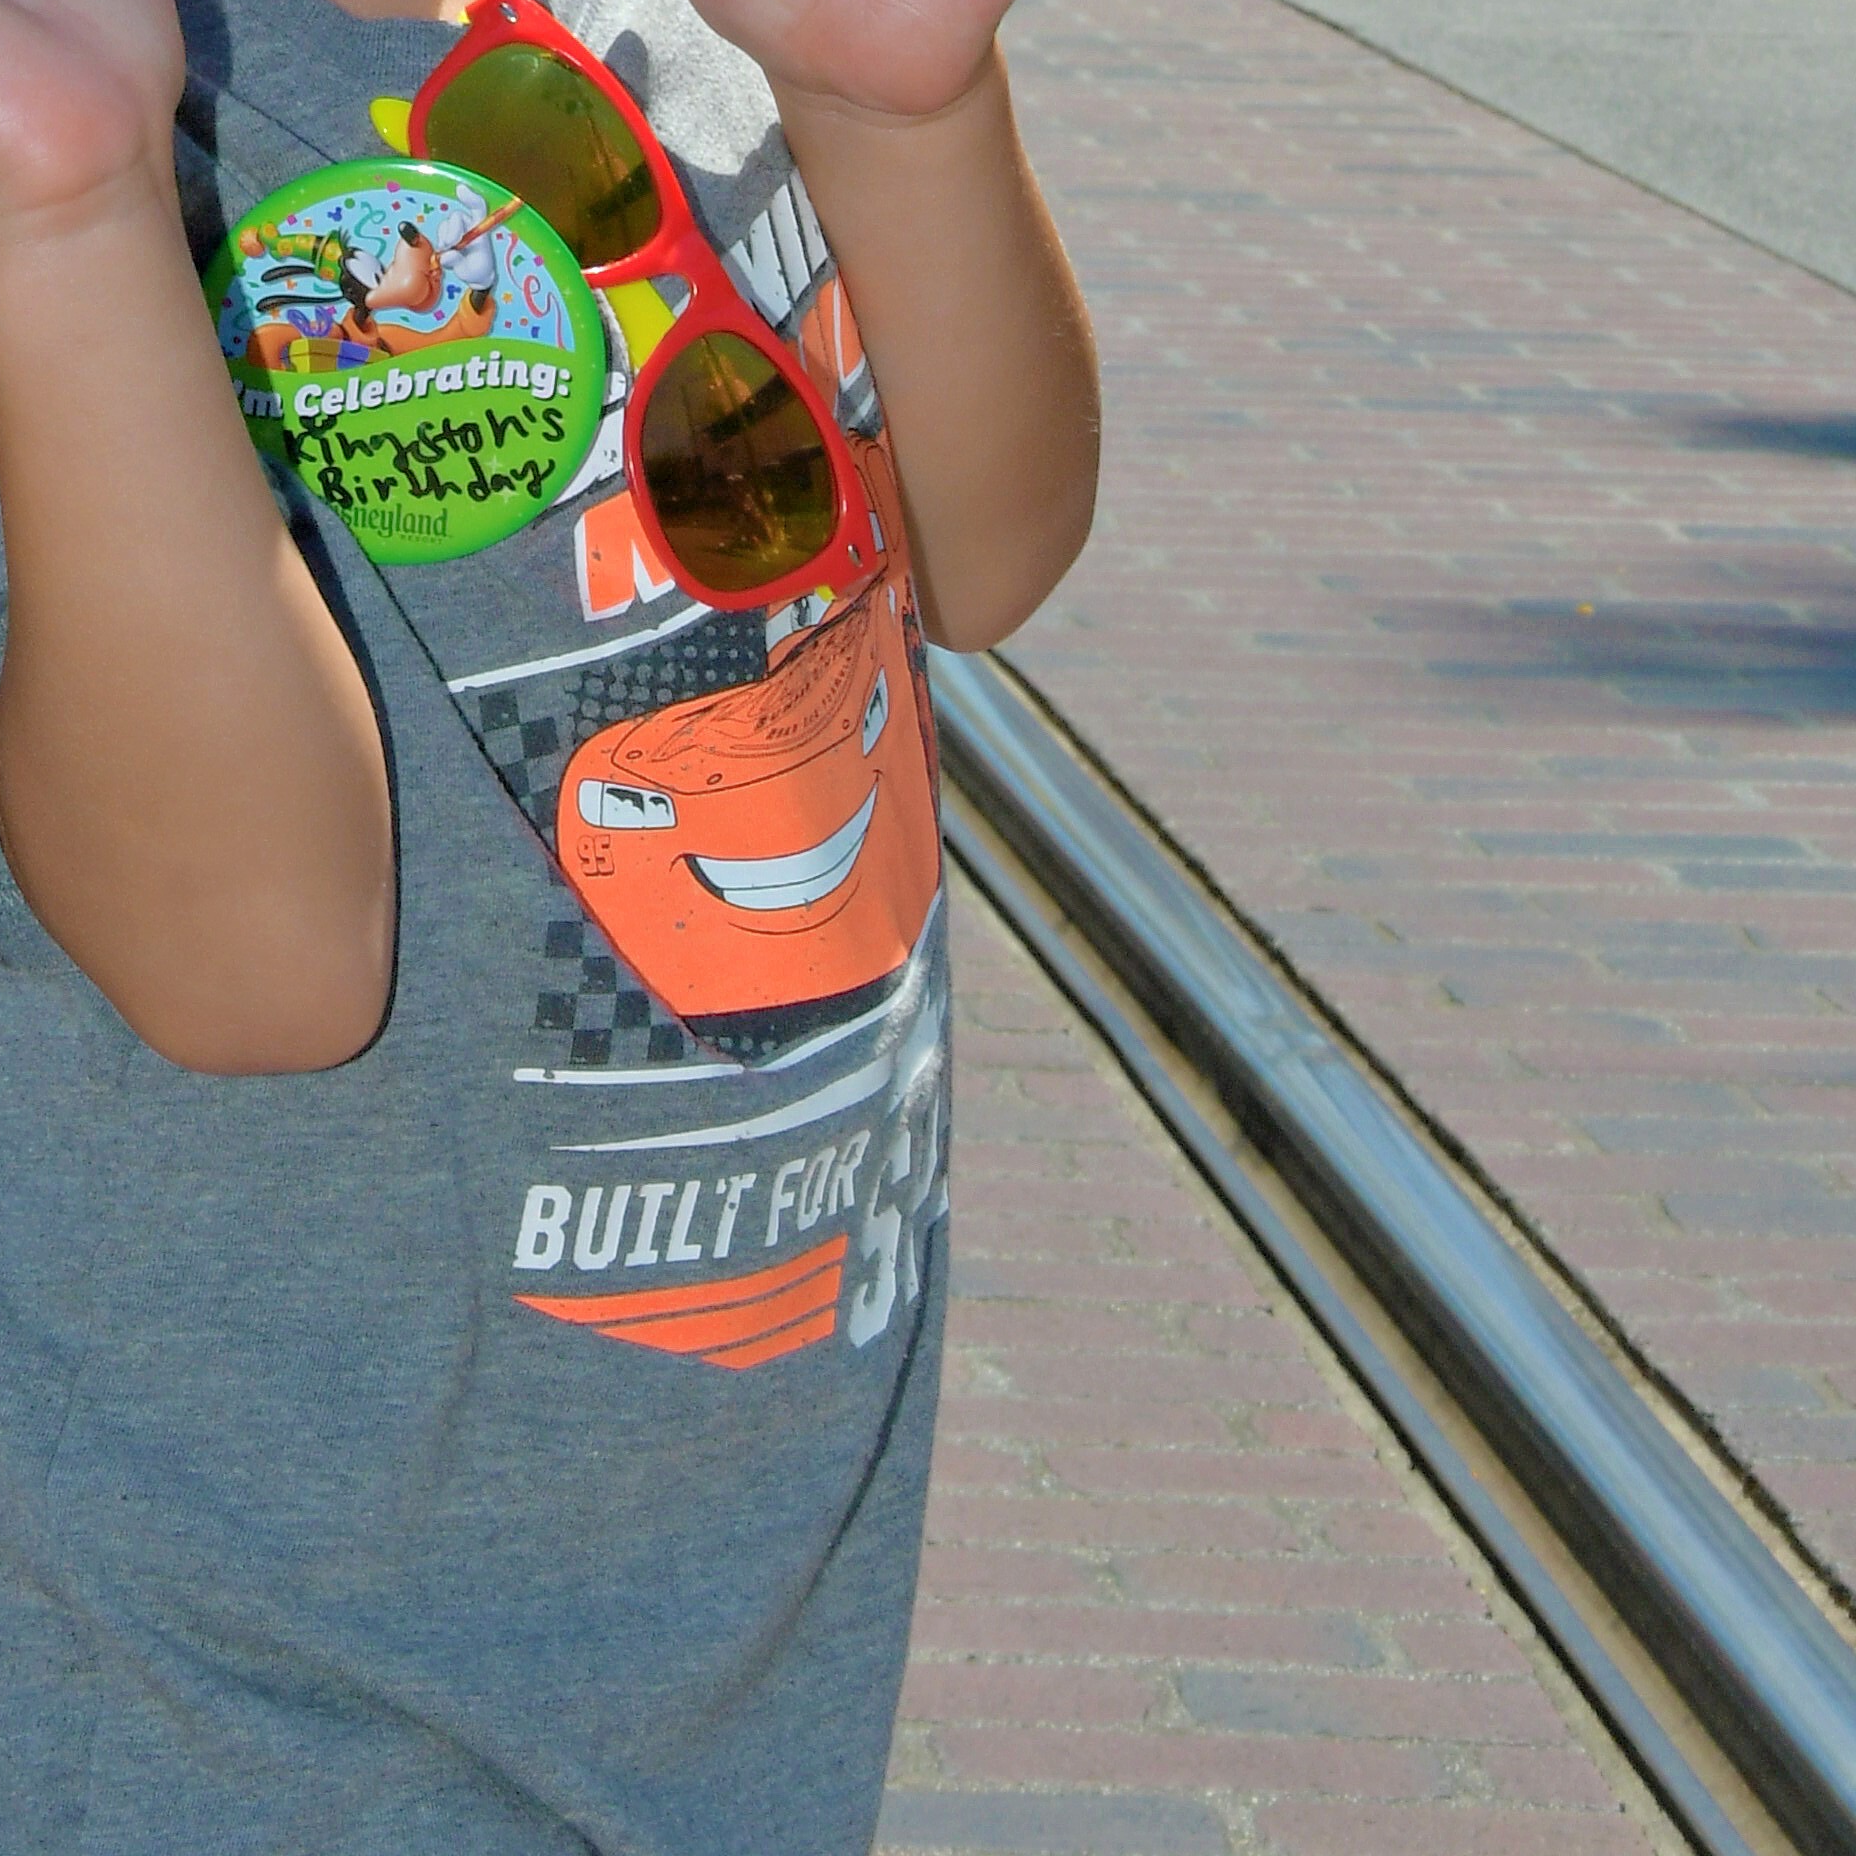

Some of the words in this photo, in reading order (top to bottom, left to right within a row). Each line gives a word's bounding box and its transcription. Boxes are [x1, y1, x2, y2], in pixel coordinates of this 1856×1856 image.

[294, 351, 572, 418] Celebrating:
[317, 455, 556, 510] Birthday
[576, 834, 615, 877] 95
[512, 1172, 757, 1271] BUILT
[764, 1129, 872, 1248] FOR
